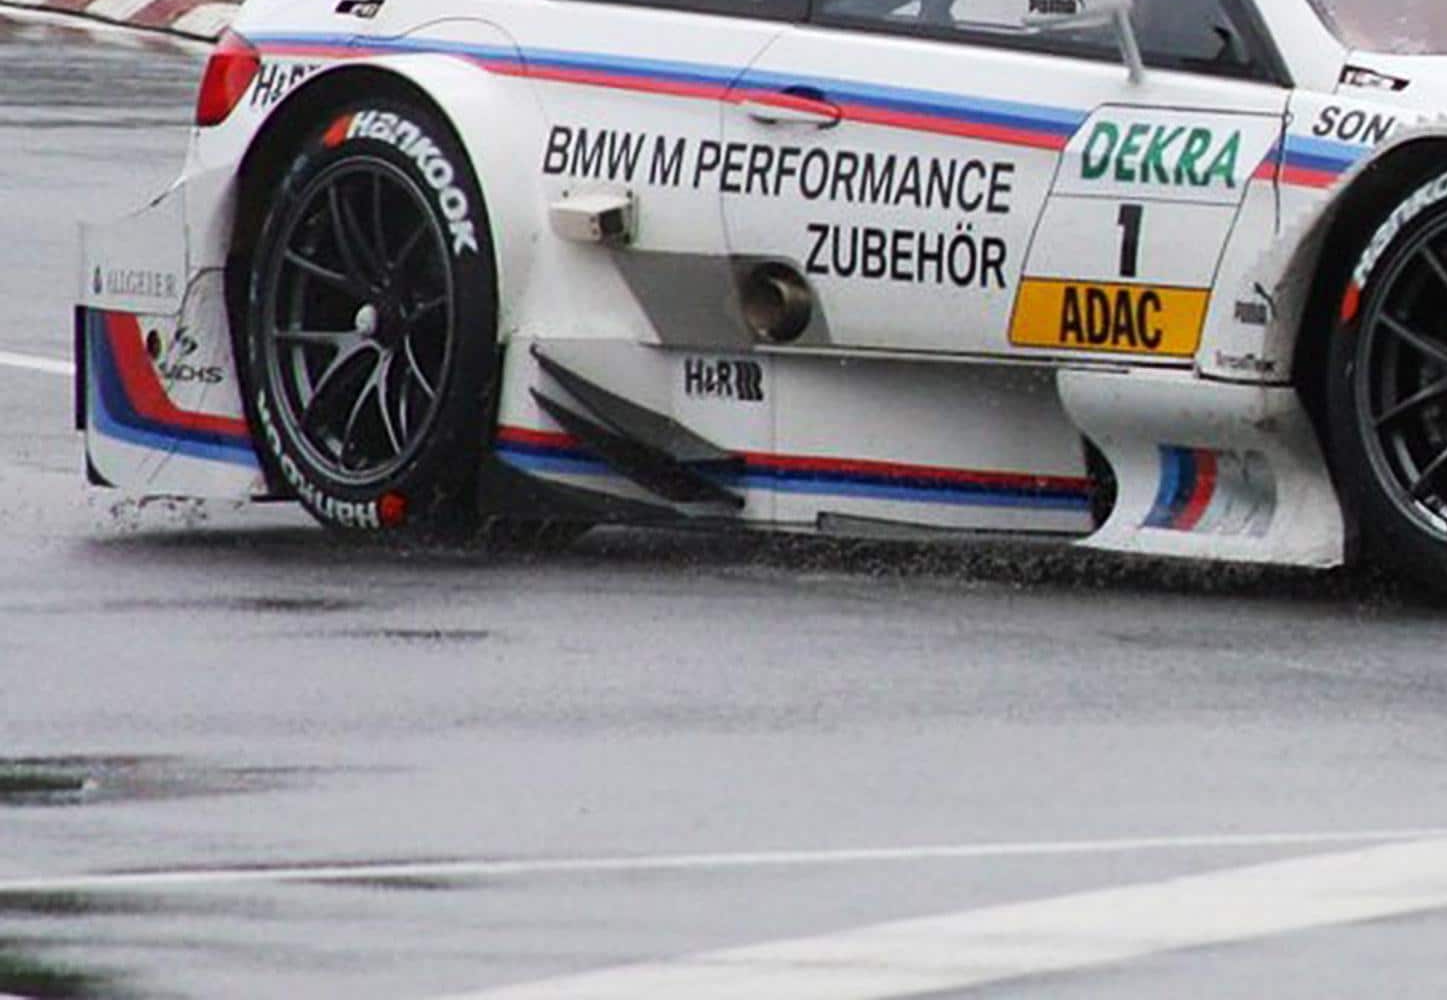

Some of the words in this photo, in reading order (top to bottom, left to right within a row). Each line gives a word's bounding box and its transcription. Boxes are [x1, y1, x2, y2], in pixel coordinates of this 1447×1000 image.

[1081, 121, 1241, 189] DEKRA
[1313, 105, 1395, 145] SON
[543, 126, 646, 180] BMW
[648, 135, 687, 187] M
[693, 141, 1016, 214] PERFORMANCE
[806, 222, 1008, 288] ZUBEHÖR
[1117, 204, 1143, 278] 1
[1059, 286, 1162, 349] ADAC
